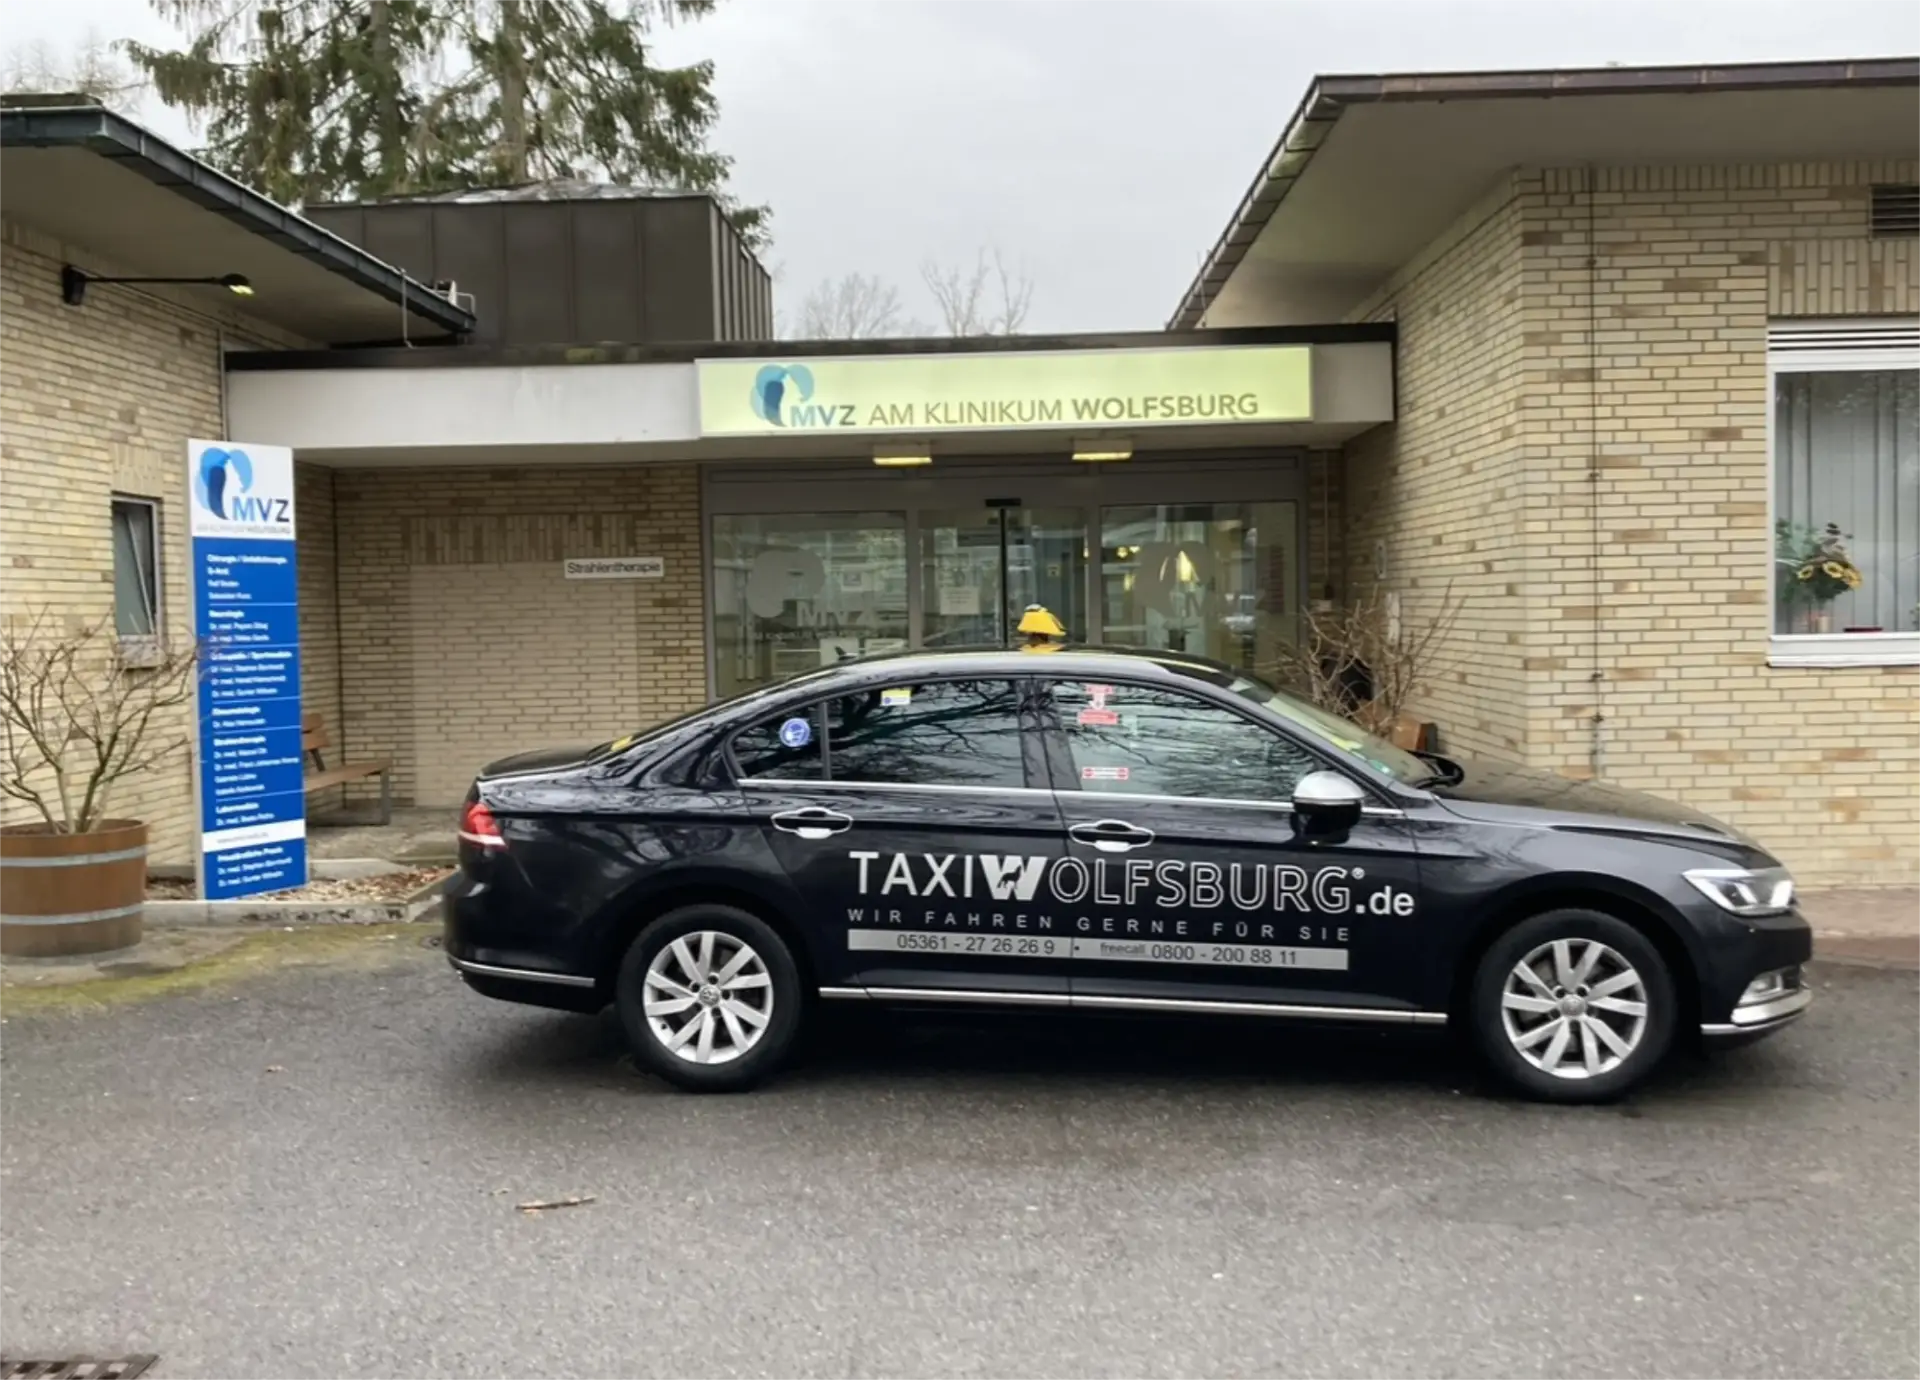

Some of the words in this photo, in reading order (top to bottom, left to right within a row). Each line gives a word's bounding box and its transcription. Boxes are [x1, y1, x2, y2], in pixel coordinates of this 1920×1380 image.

[790, 405, 856, 427] MVZ
[869, 403, 914, 426] AM
[924, 399, 1062, 425] KLINIKUM
[1072, 393, 1259, 420] WOLFSBURG
[232, 495, 290, 522] MVZ
[848, 908, 902, 923] WIR
[925, 911, 1052, 929] FAHREN
[1077, 917, 1188, 935] GERNE
[1212, 921, 1274, 938] FÜR
[1299, 926, 1349, 941] SIE
[897, 934, 948, 950] 05361
[965, 937, 985, 951] 27
[991, 938, 1013, 953] 26
[1018, 939, 1039, 954] 26
[1100, 941, 1146, 955] freecall
[1151, 944, 1195, 960] 0800
[1212, 946, 1244, 963] 200
[1249, 948, 1272, 964] 88
[1279, 949, 1297, 965] 11
